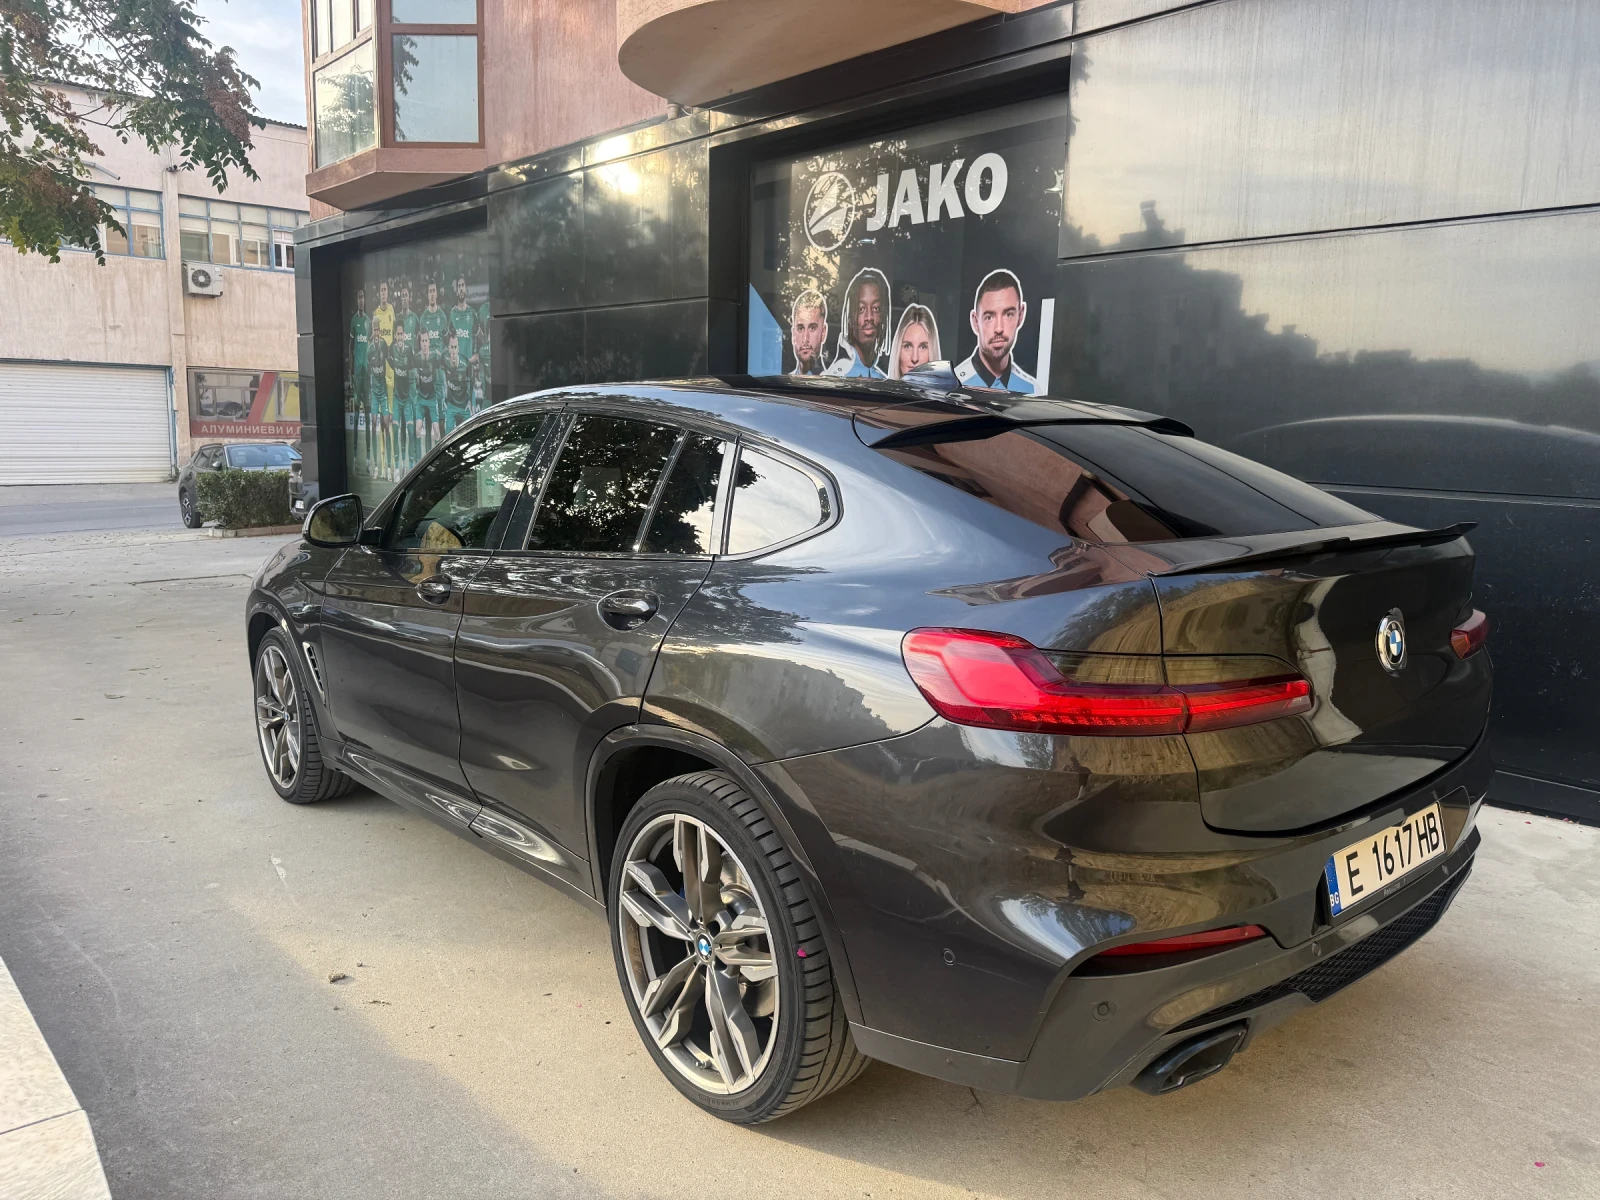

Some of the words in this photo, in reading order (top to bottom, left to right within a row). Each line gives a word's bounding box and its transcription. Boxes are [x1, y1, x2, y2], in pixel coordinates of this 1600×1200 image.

[866, 152, 1008, 232] JAKO
[201, 424, 284, 435] АЛУМИНИЕВИ
[1346, 851, 1364, 897] E
[1372, 823, 1412, 881] 1617
[1415, 812, 1440, 858] HB
[1330, 892, 1340, 906] BG
